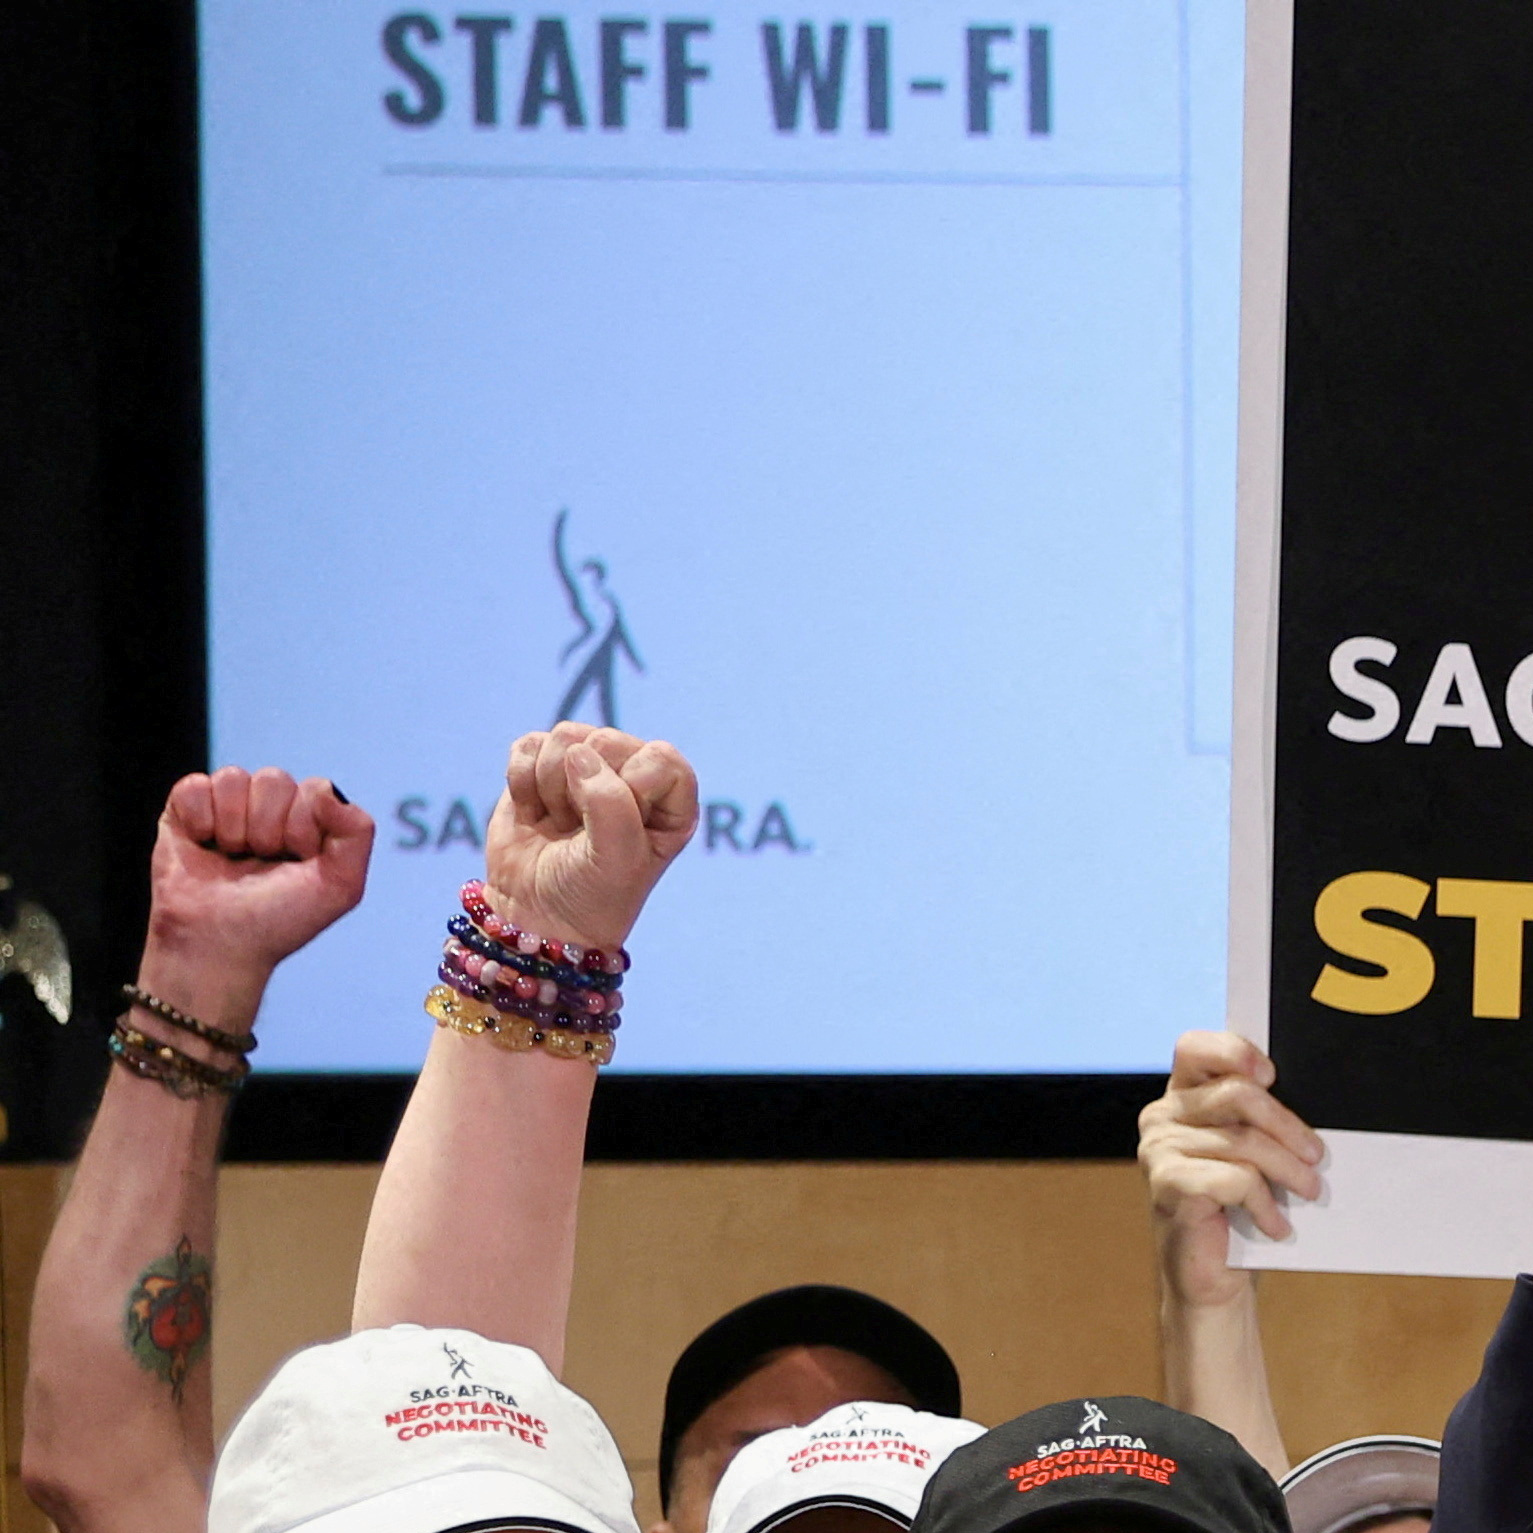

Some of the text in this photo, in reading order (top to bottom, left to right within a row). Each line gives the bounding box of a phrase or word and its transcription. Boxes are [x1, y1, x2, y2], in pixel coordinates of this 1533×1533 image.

[382, 17, 1053, 137] STAFF WI-FI
[409, 1384, 518, 1408] SAG·AFTRA
[385, 1401, 549, 1434] NEGOTIATING
[397, 1418, 547, 1449] COMMITTEE
[1037, 1434, 1147, 1459] SAG·AFTRA
[786, 1440, 932, 1464] NEGOTIATING
[790, 1452, 926, 1474] COMMITTEE
[1008, 1449, 1178, 1480] NEGOTIATING
[1016, 1462, 1171, 1493] COMMITTEE
